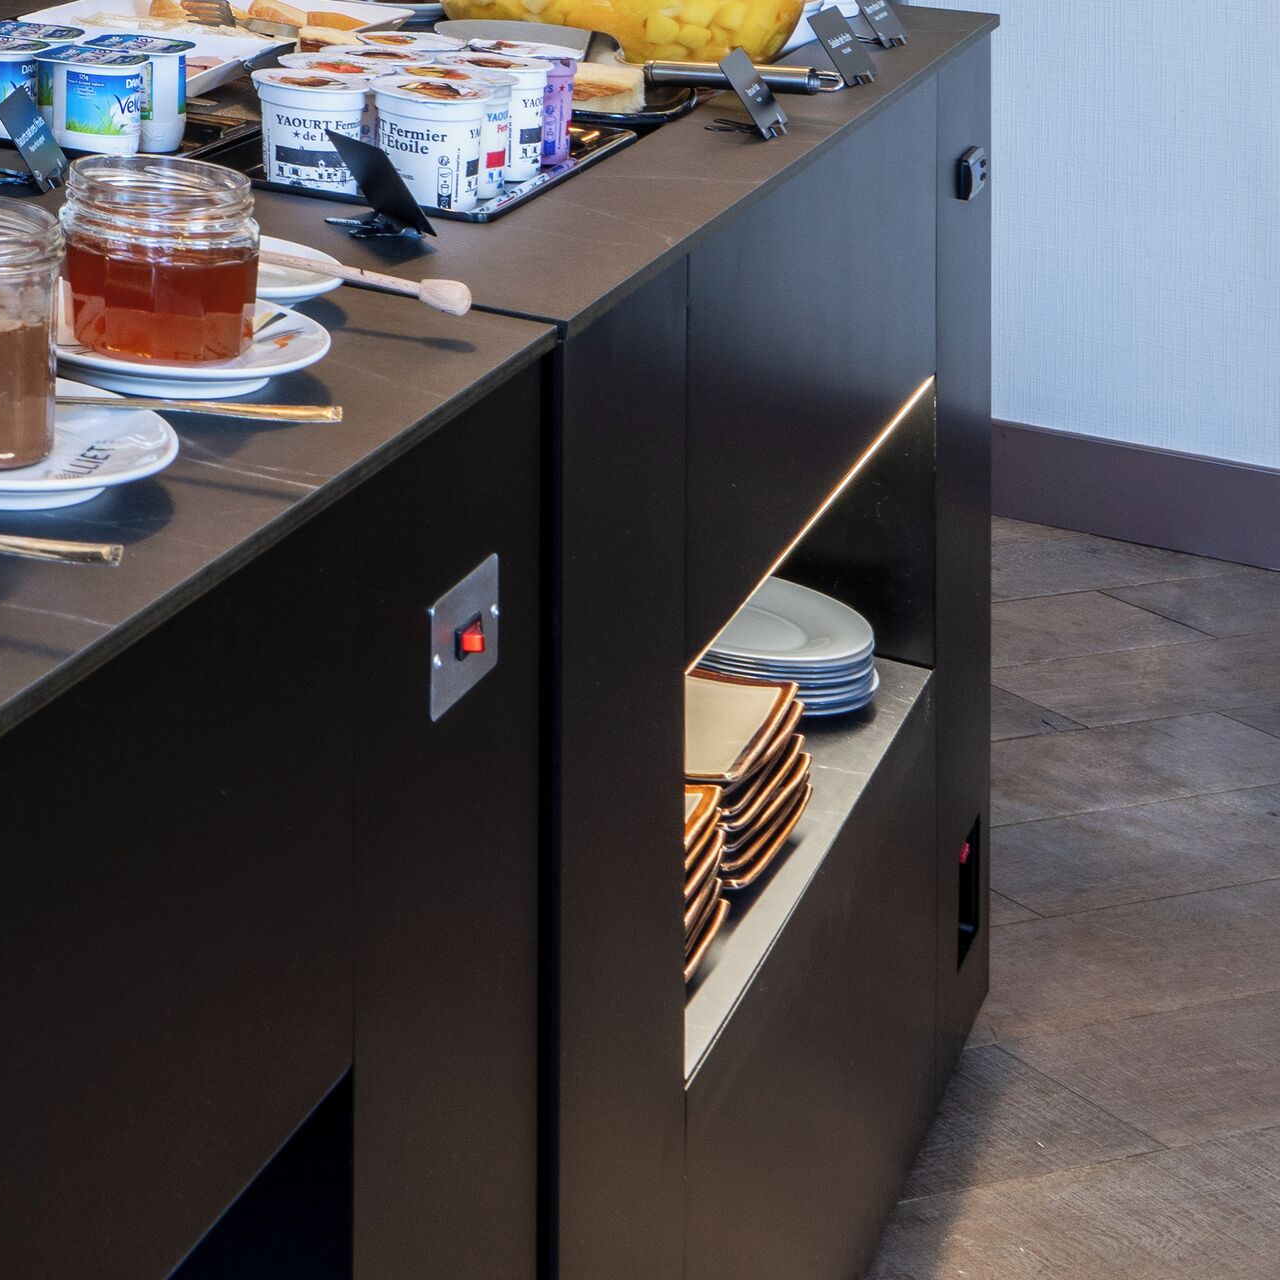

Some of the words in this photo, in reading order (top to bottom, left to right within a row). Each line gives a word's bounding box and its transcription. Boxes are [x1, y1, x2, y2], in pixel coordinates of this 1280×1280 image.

[276, 113, 334, 131] YAOURT
[302, 131, 318, 142] de
[389, 124, 448, 144] Fermier
